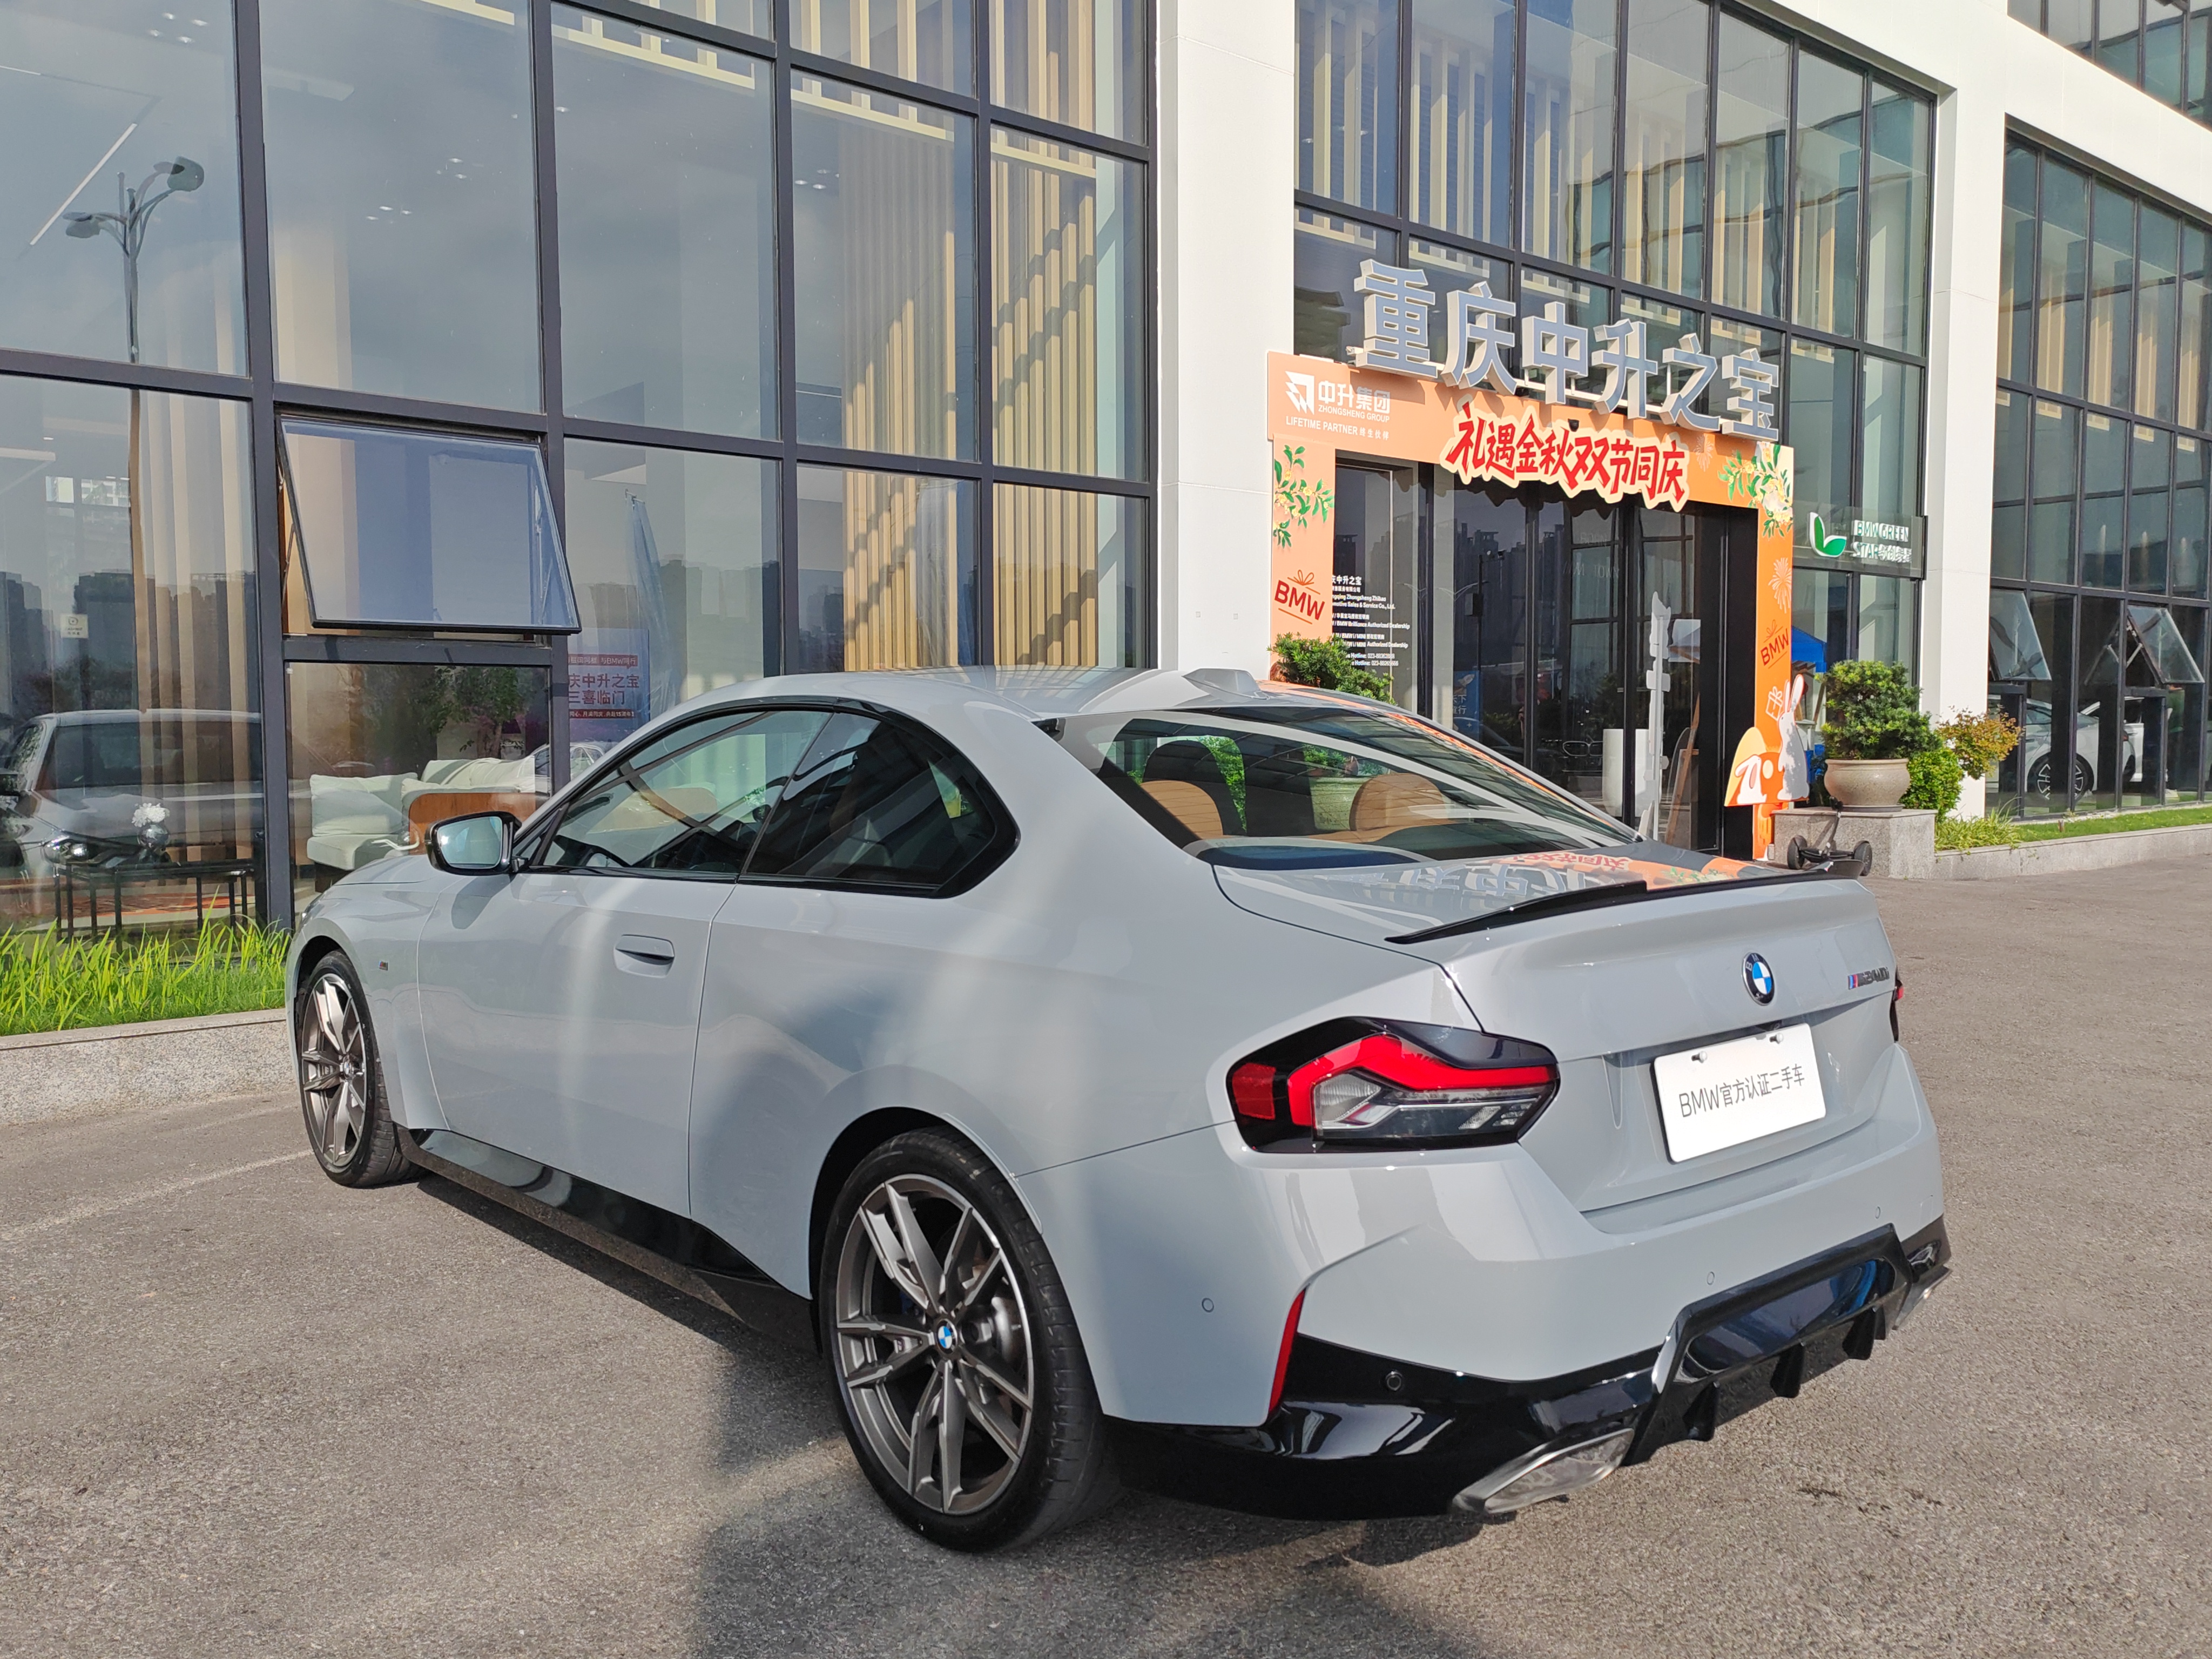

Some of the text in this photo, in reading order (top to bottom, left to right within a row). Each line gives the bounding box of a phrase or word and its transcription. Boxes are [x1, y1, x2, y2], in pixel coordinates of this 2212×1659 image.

[1354, 259, 1779, 442] 重庆中升之宝
[1318, 380, 1390, 414] 中升集团
[1318, 404, 1390, 423] ZHONGSHENG GROUP
[1286, 416, 1389, 441] LIFETIME PARTNER 终生伙伴
[1446, 402, 1686, 505] 礼遇金秋双节同庆
[1853, 520, 1909, 542] BMW GREEN
[1852, 542, 1878, 559] STAR
[1274, 579, 1325, 621] BMW
[1346, 594, 1372, 602] Zhongsheng
[1761, 628, 1789, 666] BMW
[569, 690, 625, 705] 三喜临门
[1679, 1063, 1805, 1118] BMW官方认证二手车
